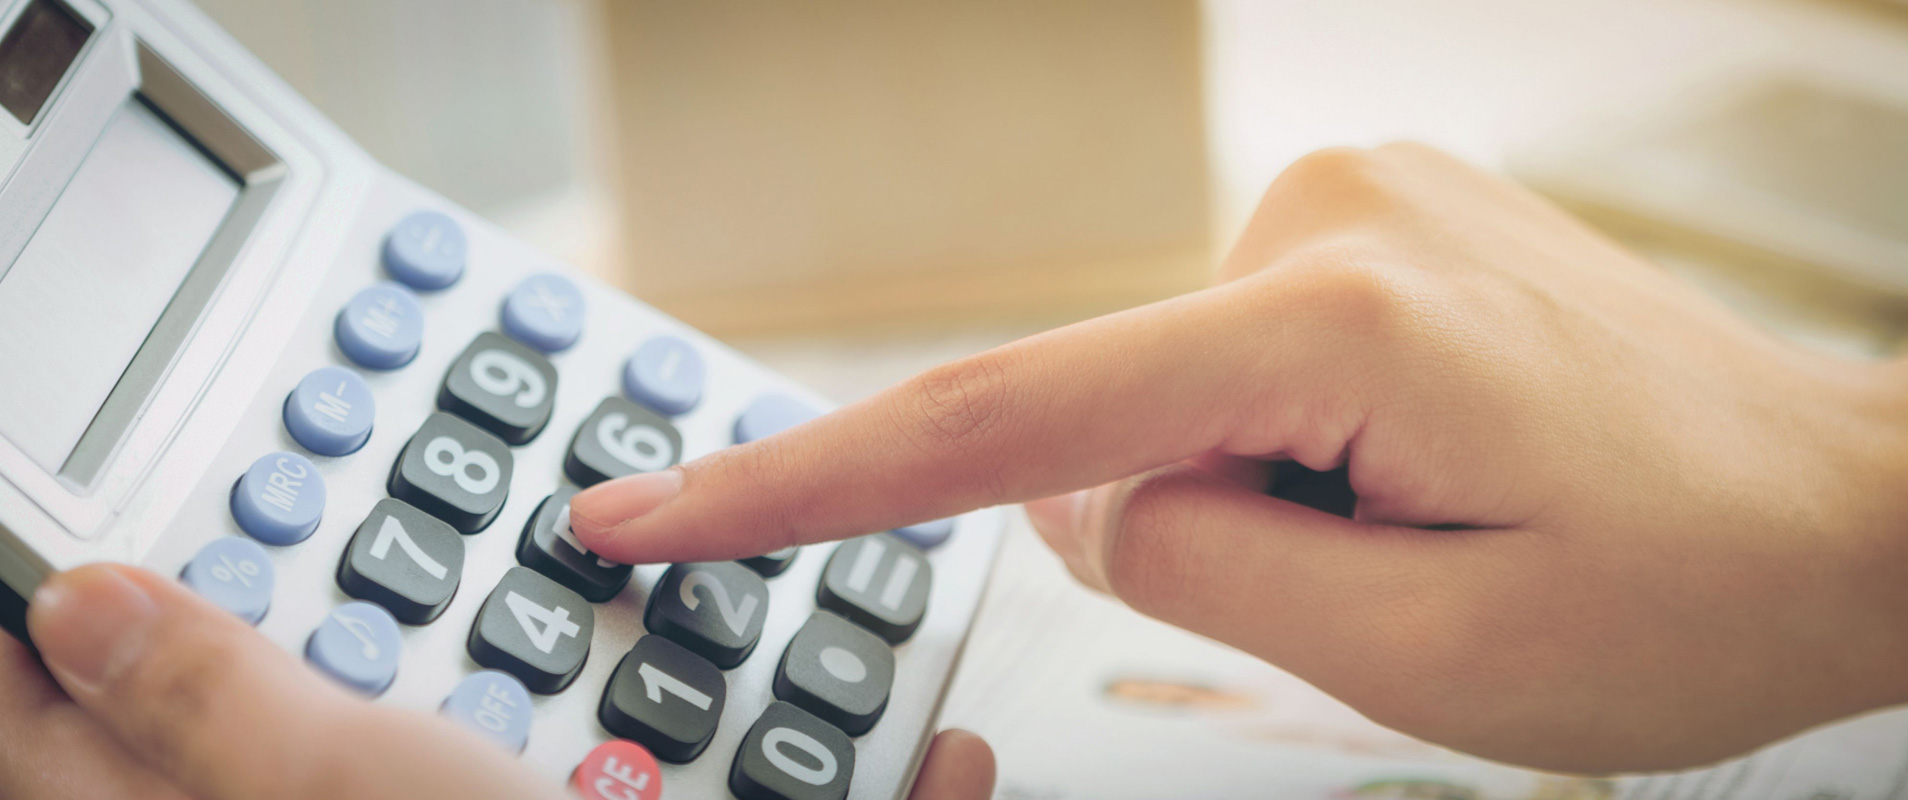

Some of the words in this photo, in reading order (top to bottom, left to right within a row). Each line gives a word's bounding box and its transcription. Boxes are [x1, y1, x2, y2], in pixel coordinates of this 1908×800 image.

[361, 295, 407, 339] M+
[313, 379, 354, 424] M-
[469, 348, 548, 409] 9
[423, 435, 501, 495] 8
[595, 411, 674, 473] 6
[261, 456, 308, 513] MRC
[211, 553, 260, 589] %
[368, 514, 449, 582] 7
[504, 590, 581, 655] 4
[678, 569, 759, 639] 2
[474, 682, 519, 733] OFF
[637, 660, 714, 712] 1
[760, 726, 838, 787] 0
